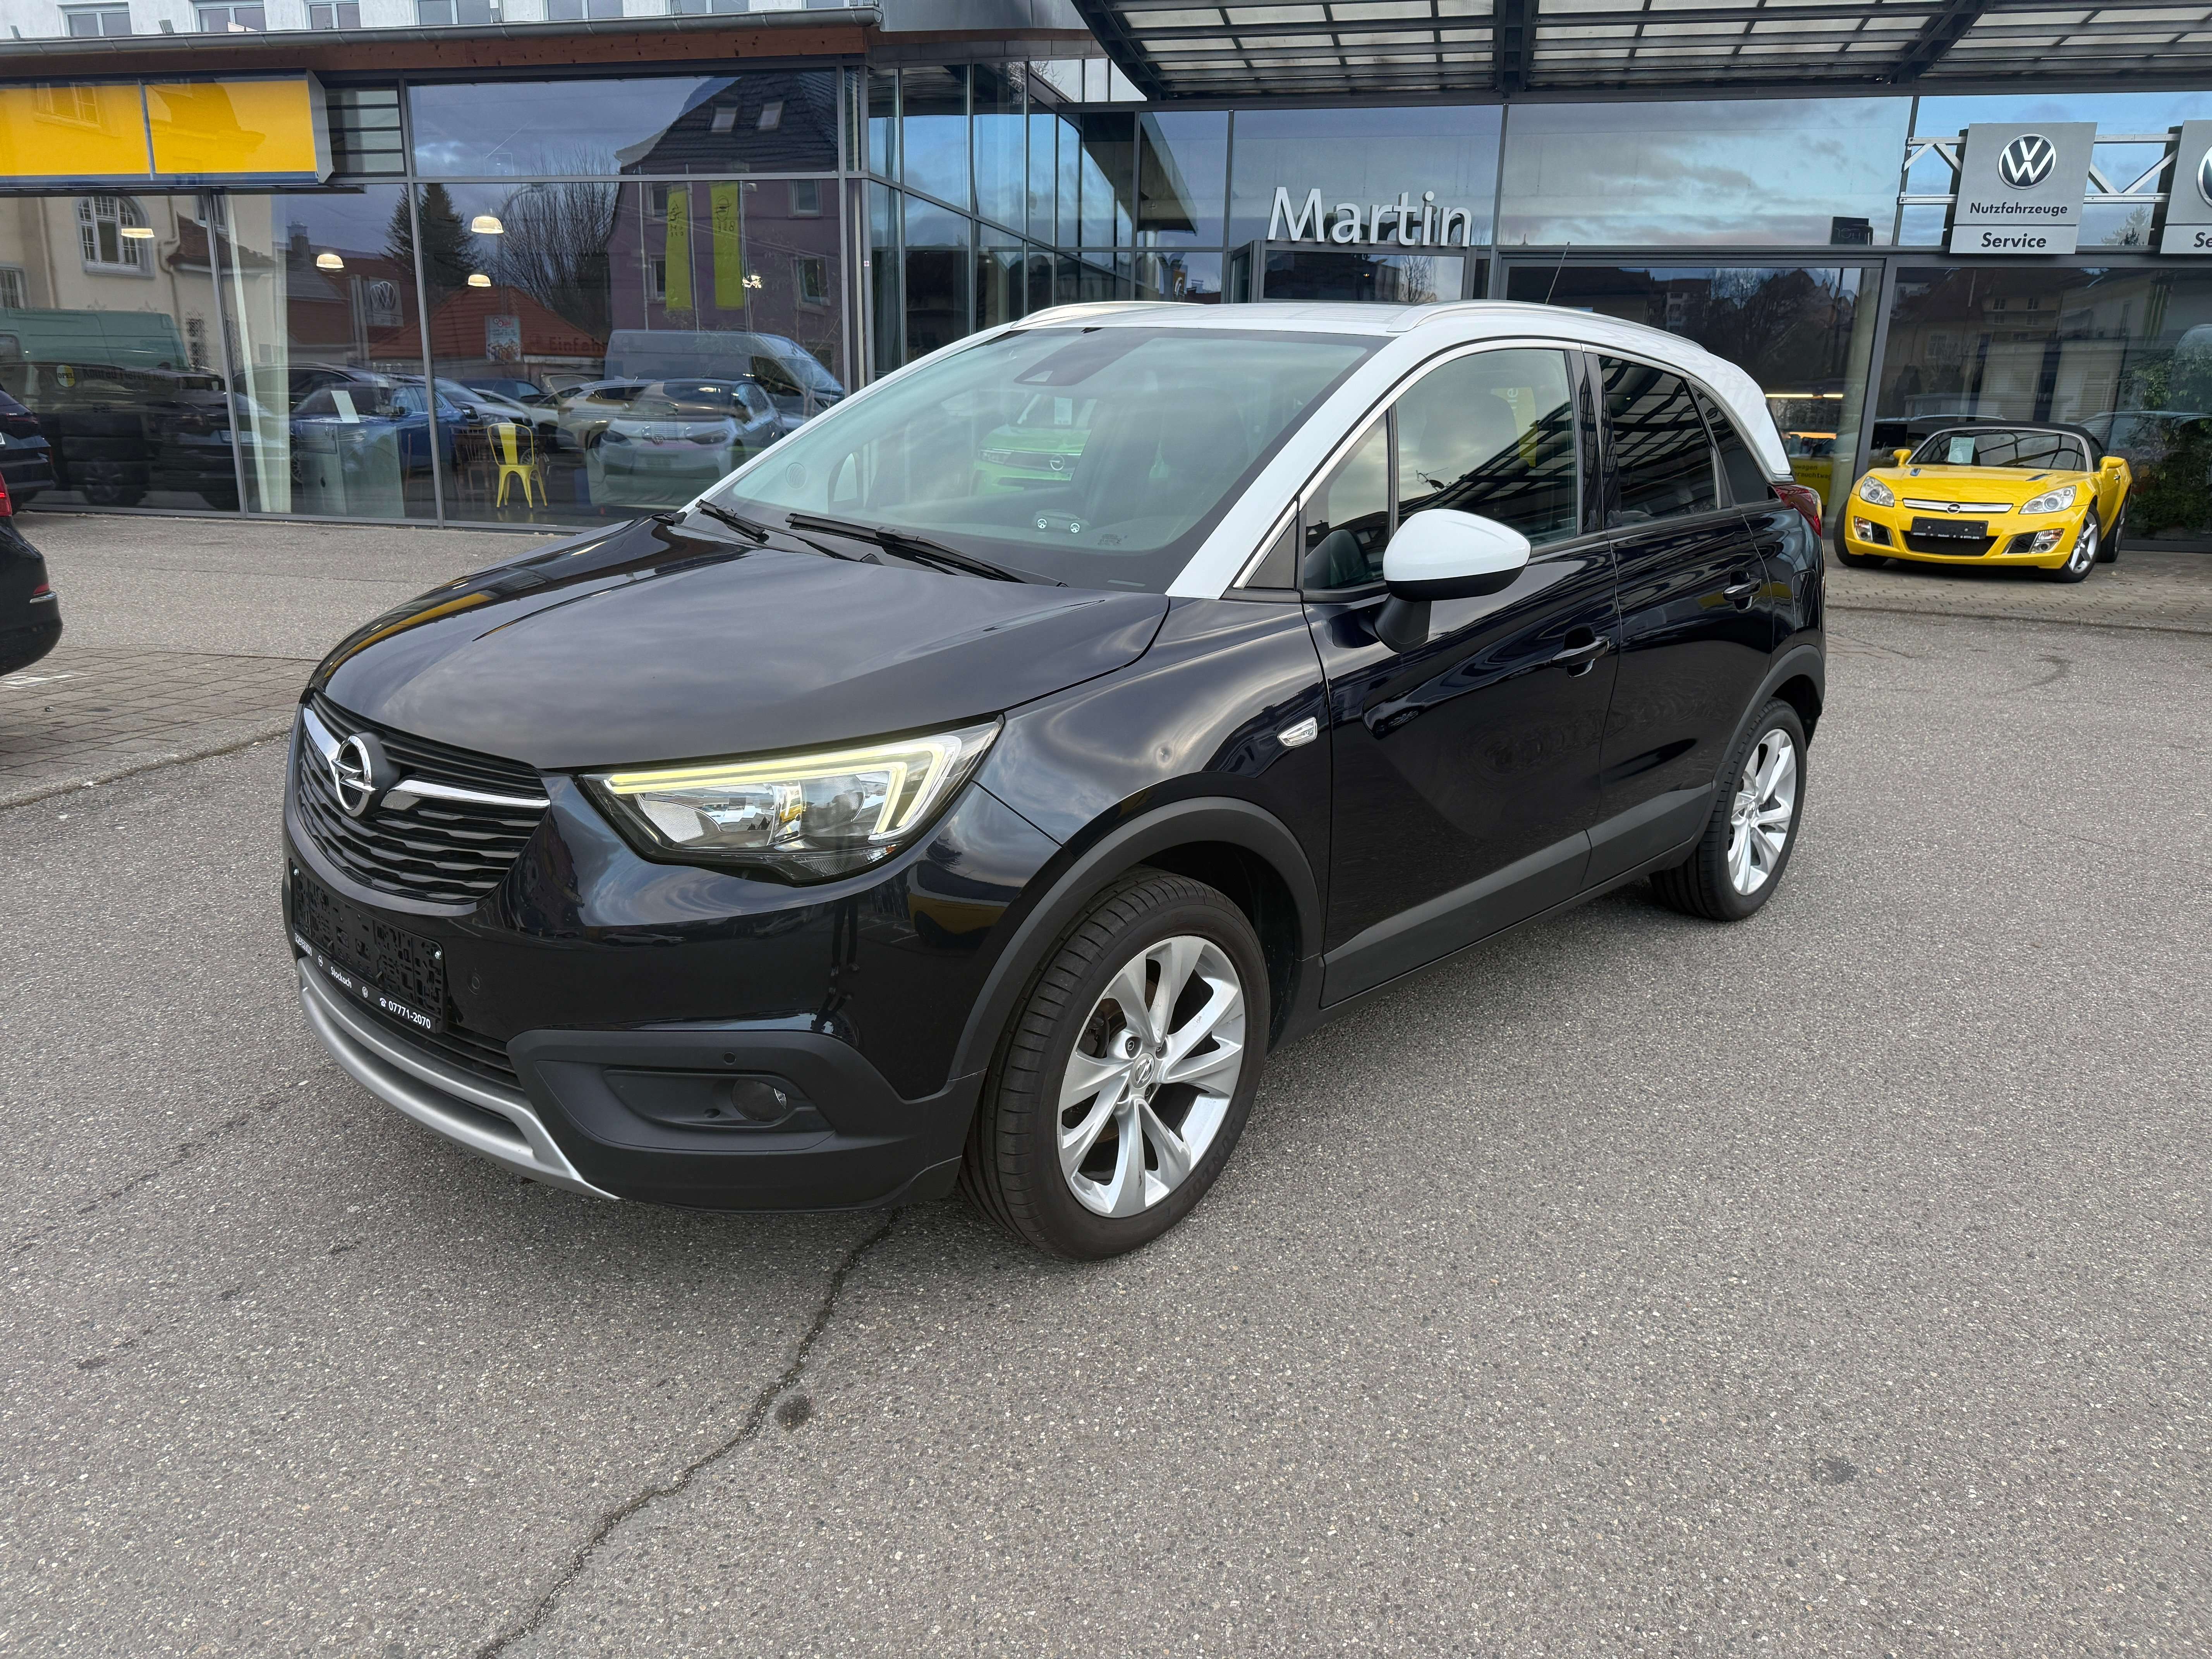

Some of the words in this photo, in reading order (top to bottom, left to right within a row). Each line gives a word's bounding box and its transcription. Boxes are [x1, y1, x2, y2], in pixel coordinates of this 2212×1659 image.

[1267, 187, 1472, 247] Martin
[1970, 202, 2068, 217] Nutzfahrzeuge
[1981, 232, 2047, 248] Service
[331, 967, 352, 988] Stockach
[388, 1001, 431, 1029] 07771-2070
